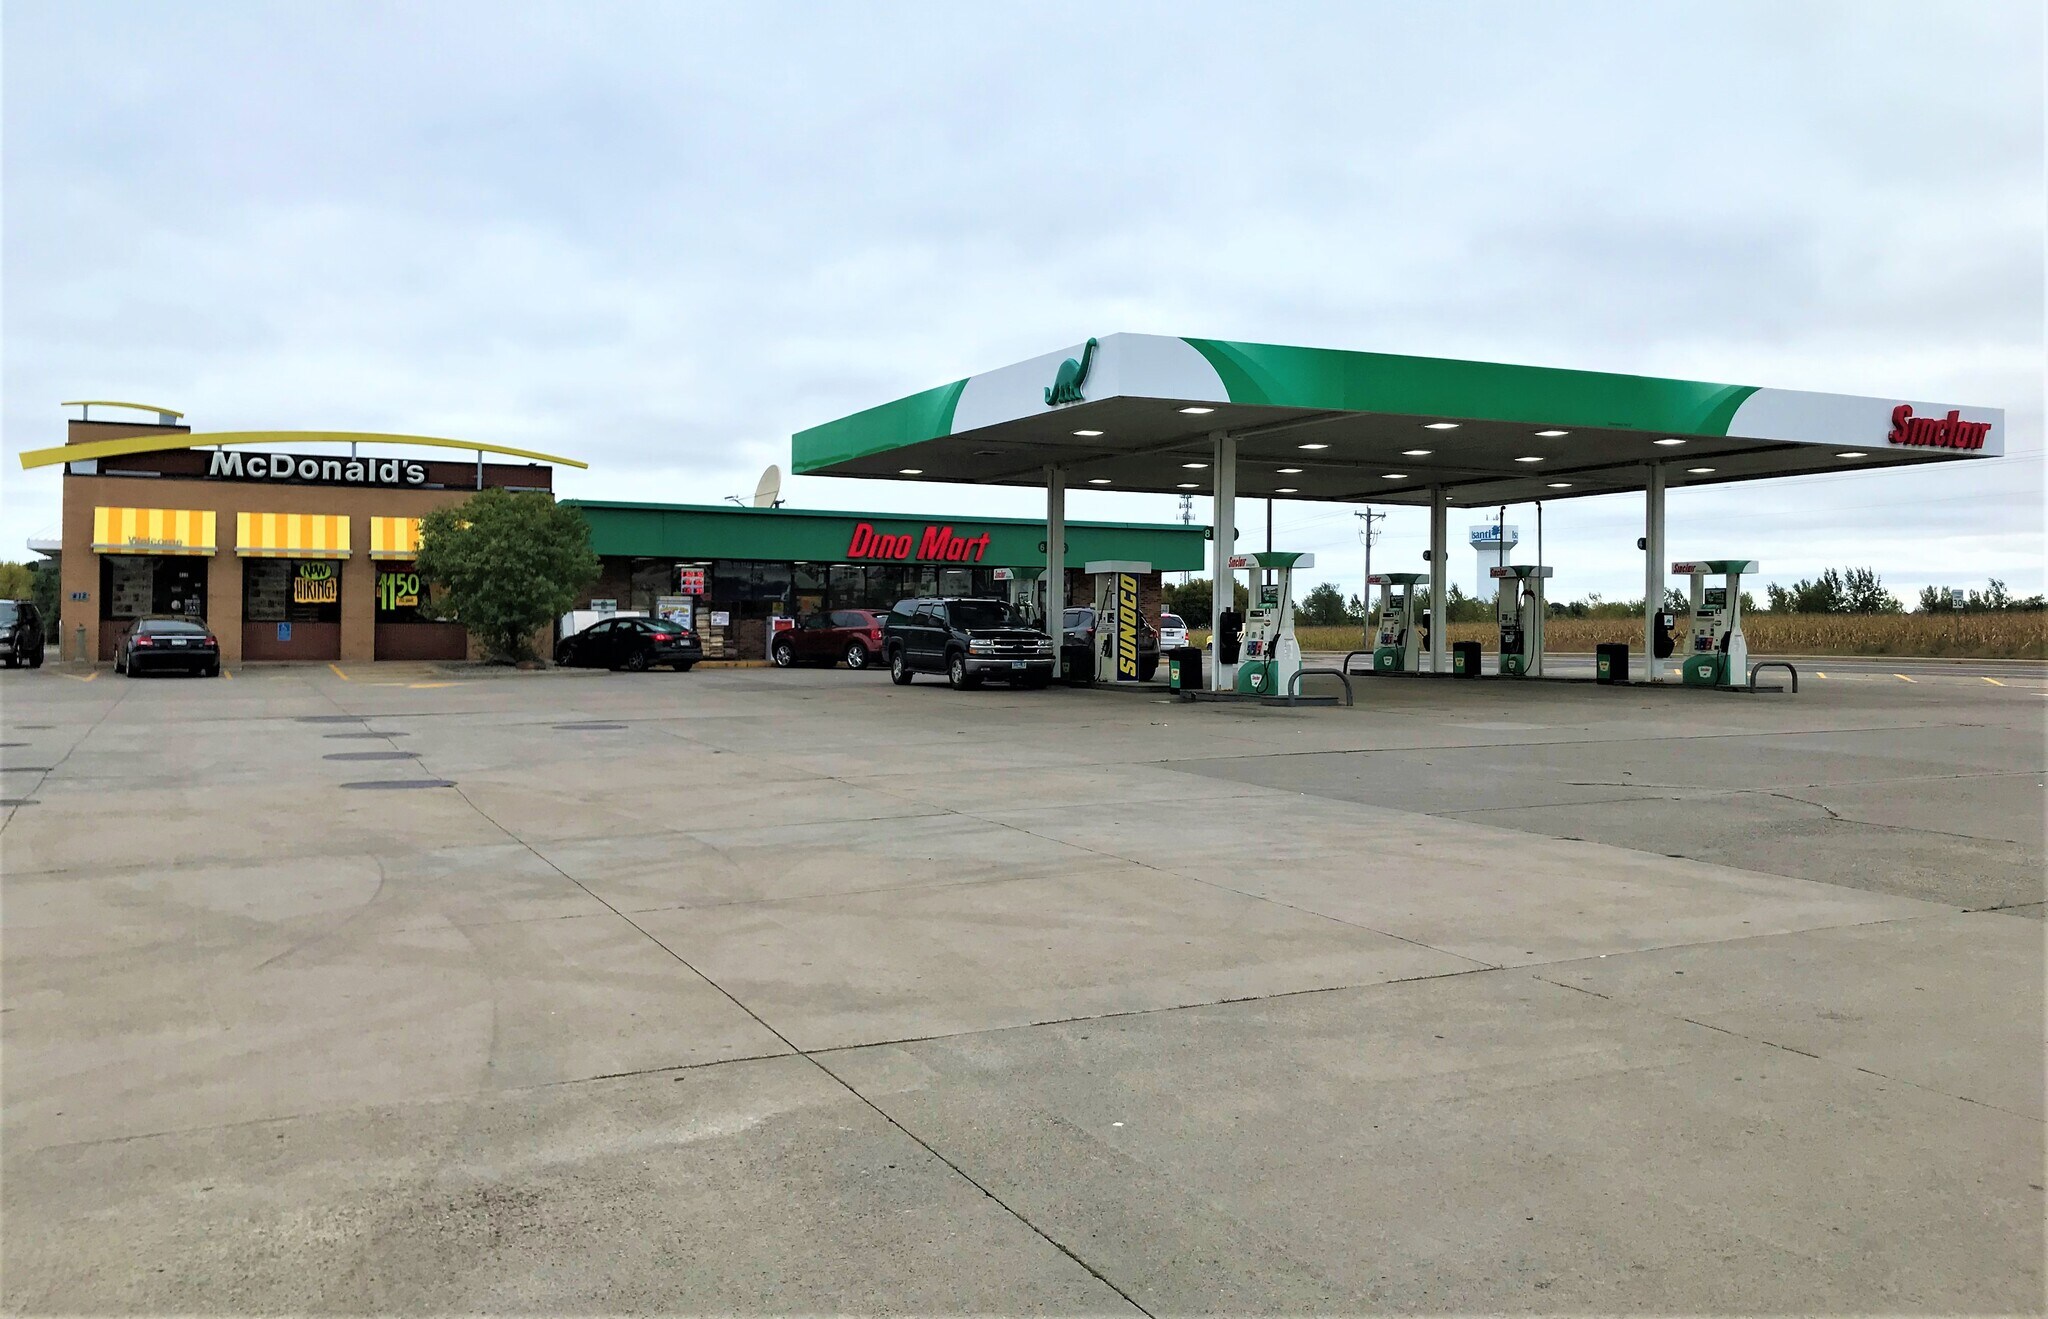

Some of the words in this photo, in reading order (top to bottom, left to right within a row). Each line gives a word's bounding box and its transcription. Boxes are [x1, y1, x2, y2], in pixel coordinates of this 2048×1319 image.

[1888, 404, 1992, 450] Sinclair
[209, 451, 425, 484] McDonald's
[847, 522, 913, 560] Dino
[916, 525, 991, 562] Mart
[1204, 529, 1211, 538] 8
[303, 562, 327, 578] NOW
[1673, 563, 1697, 573] Sinclair
[295, 579, 336, 600] HIRING!
[1953, 599, 1963, 607] 30
[1120, 573, 1137, 677] SUNOCO
